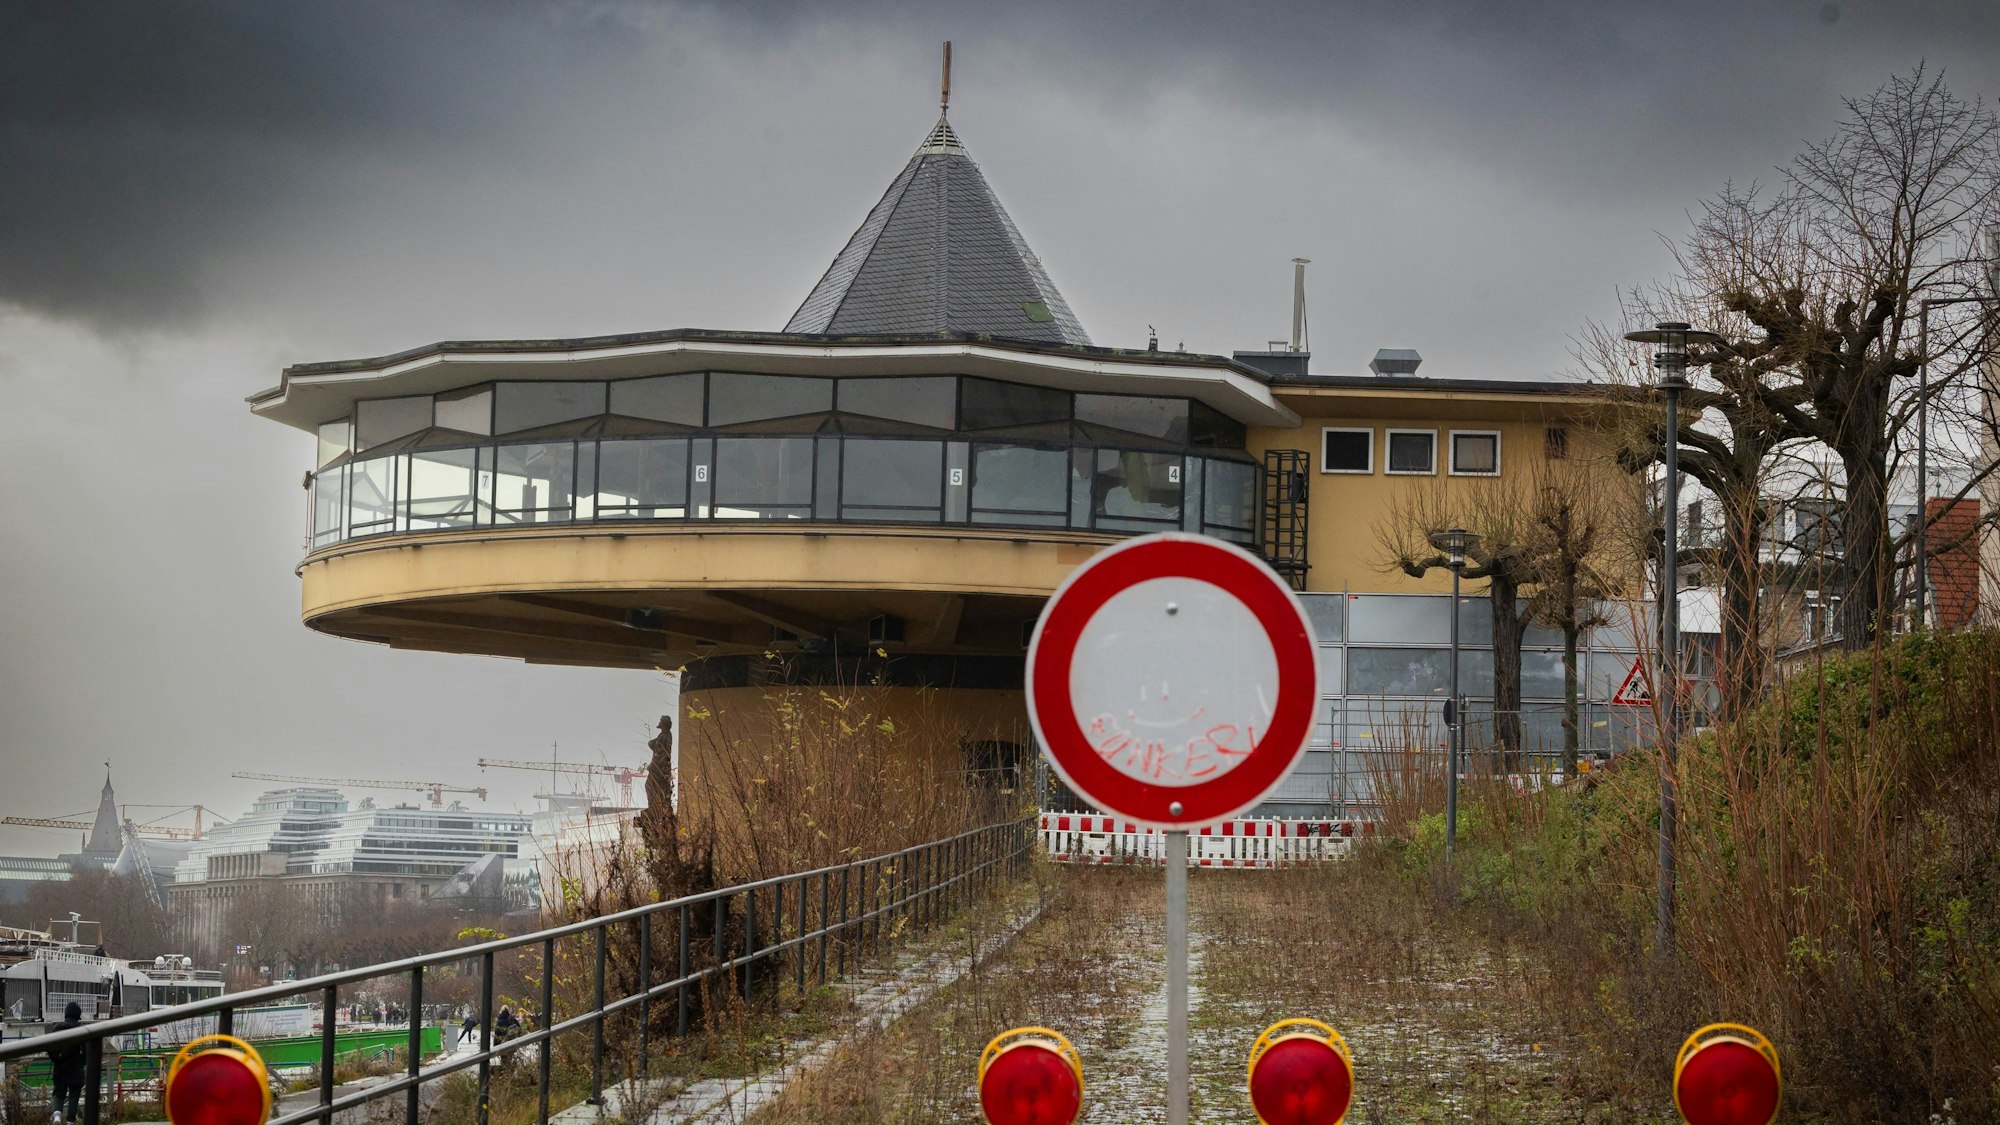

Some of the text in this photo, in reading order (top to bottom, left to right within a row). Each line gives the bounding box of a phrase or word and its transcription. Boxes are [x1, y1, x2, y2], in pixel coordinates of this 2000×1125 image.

[697, 467, 706, 480] 6
[952, 471, 961, 483] 5
[1170, 468, 1178, 480] 4
[482, 475, 489, 487] 7
